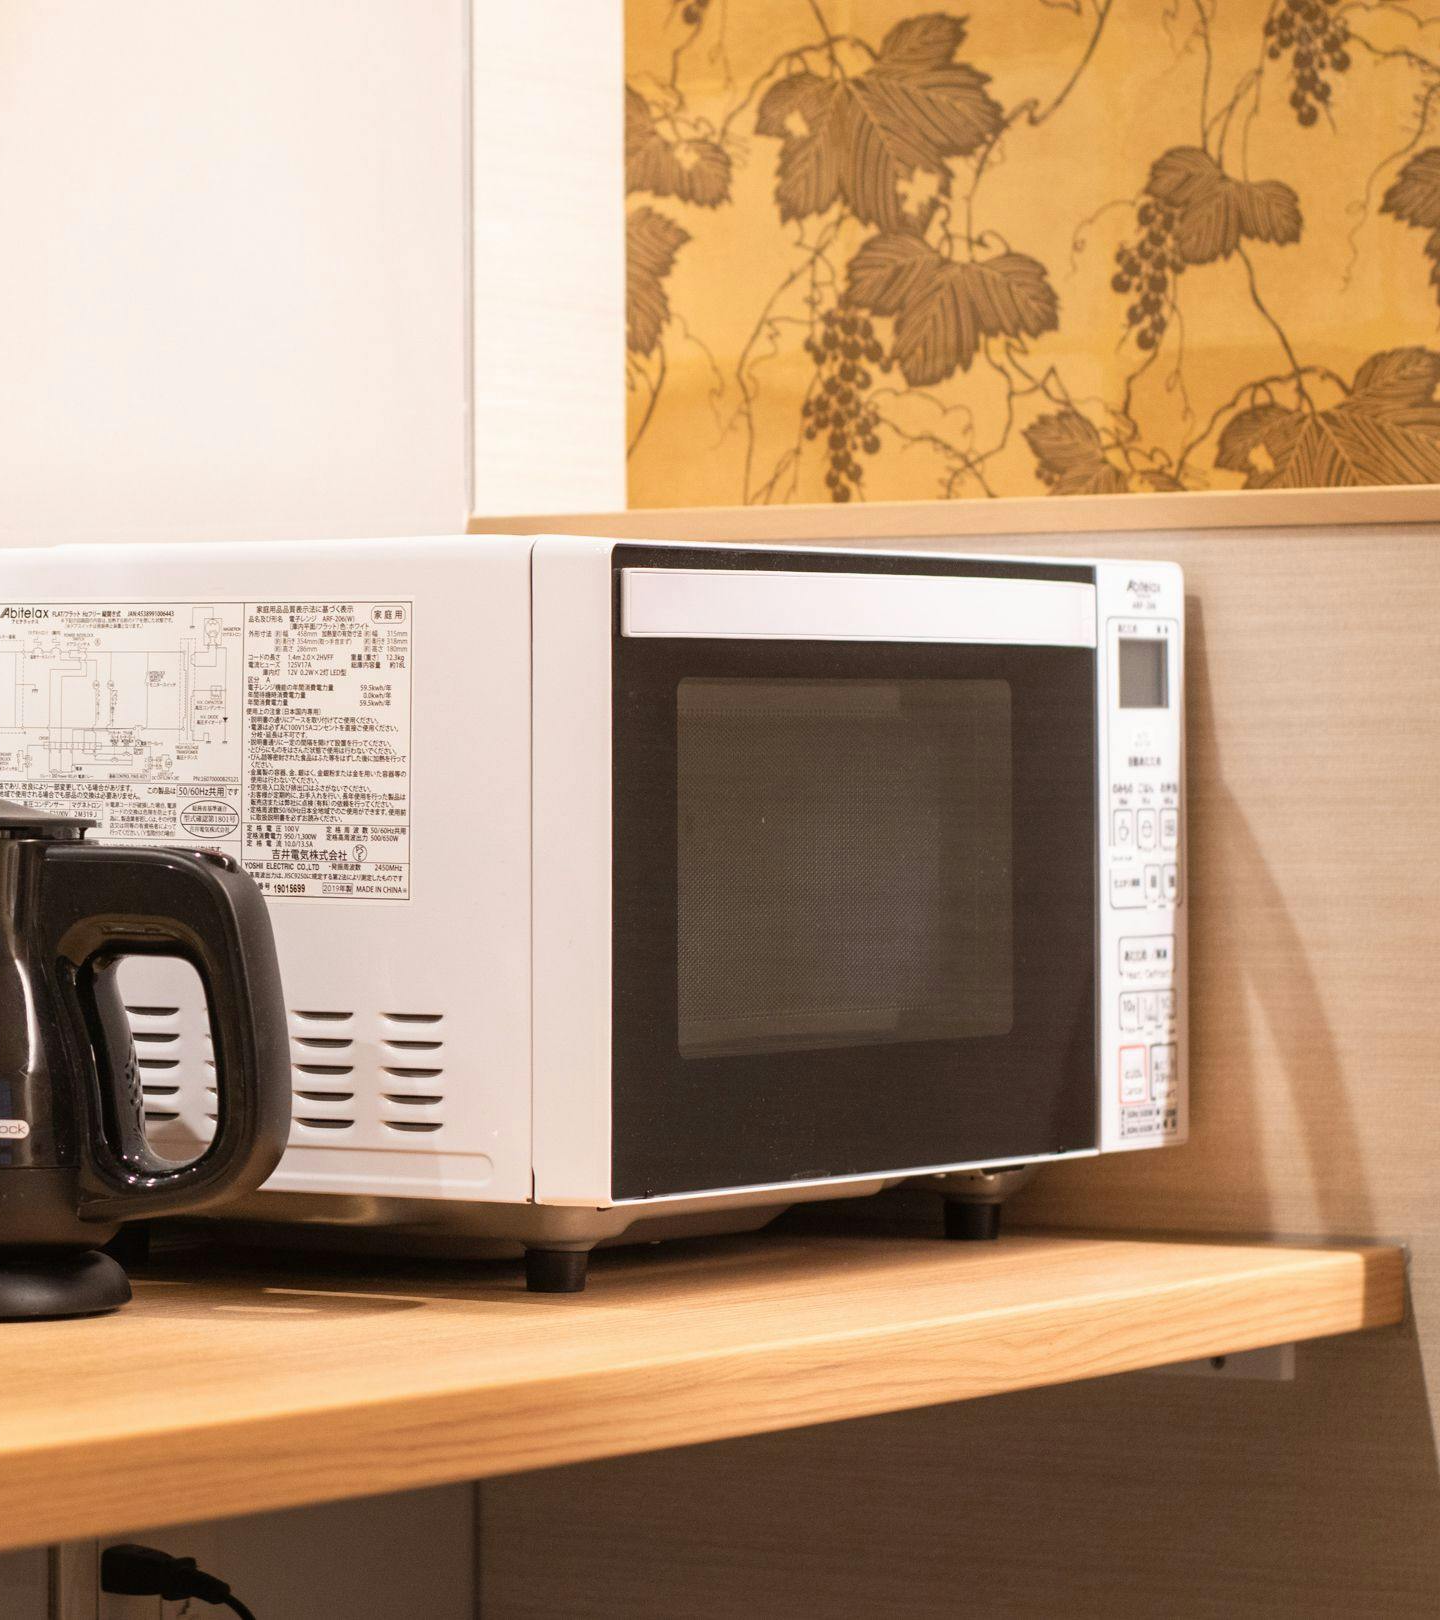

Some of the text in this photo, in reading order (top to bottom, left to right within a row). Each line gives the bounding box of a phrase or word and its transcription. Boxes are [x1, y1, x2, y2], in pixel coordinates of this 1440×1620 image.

[0, 607, 49, 619] Abitelax
[178, 786, 225, 796] 50/60Hz共用
[272, 848, 348, 861] 吉井電気株式会社
[274, 884, 306, 893] 19015699
[322, 884, 353, 893] 2019年製
